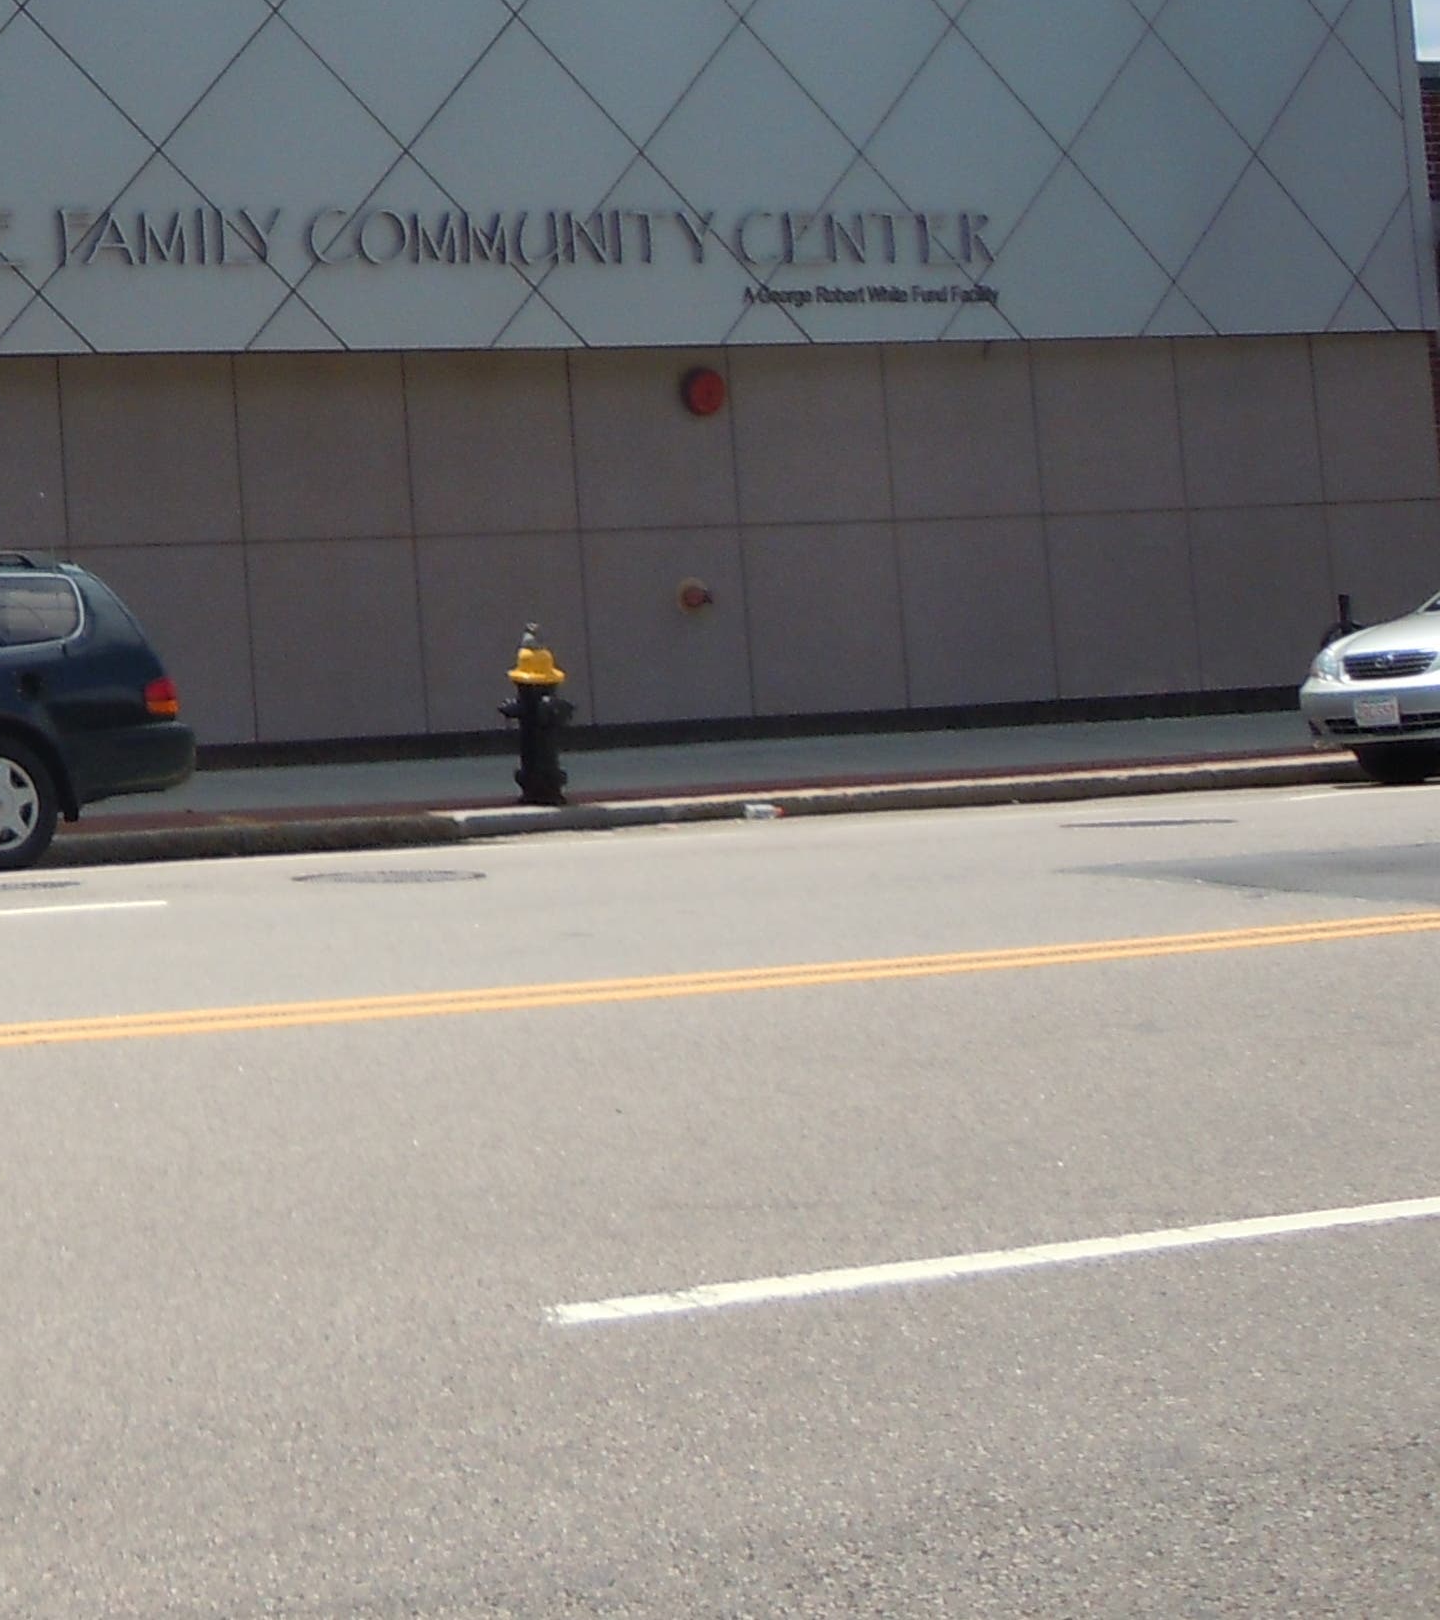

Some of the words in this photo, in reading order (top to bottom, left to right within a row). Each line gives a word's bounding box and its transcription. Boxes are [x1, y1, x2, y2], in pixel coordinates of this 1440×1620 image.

[56, 206, 280, 267] FAMILY
[306, 207, 713, 267] COMMUNITY
[732, 209, 996, 266] CENTER
[758, 288, 812, 307] George
[816, 286, 865, 302] Robert
[867, 286, 908, 302] White
[912, 285, 948, 302] Fund
[952, 284, 999, 303] Facility
